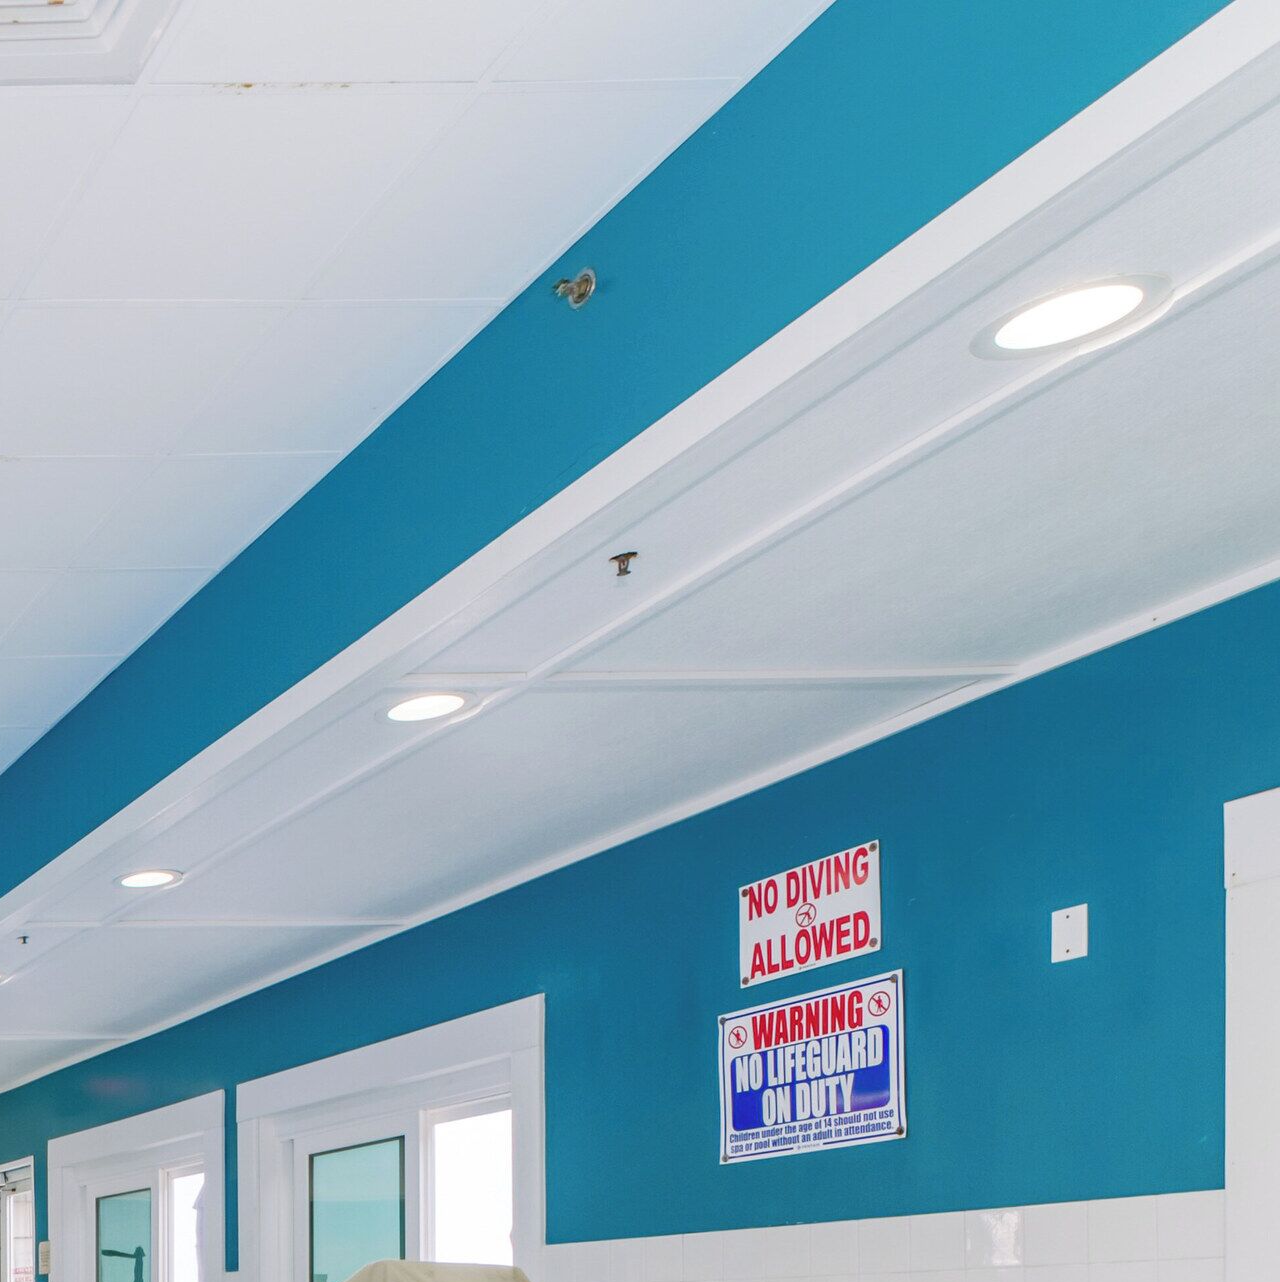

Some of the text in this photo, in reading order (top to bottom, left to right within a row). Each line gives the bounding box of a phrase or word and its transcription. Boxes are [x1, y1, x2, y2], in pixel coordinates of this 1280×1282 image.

[748, 847, 869, 921] NO DIVING
[751, 990, 863, 1050] WARNING
[735, 1027, 883, 1093] NO LIFEGUARD
[729, 1108, 894, 1144] Children under the age of 14 should not use
[761, 1072, 854, 1127] ON DUTY
[730, 1144, 744, 1154] spa
[745, 1143, 753, 1152] or
[754, 1139, 770, 1151] pool
[771, 1135, 800, 1147] without
[801, 1134, 811, 1143] an
[812, 1129, 833, 1141] adult
[834, 1127, 843, 1138] in
[844, 1120, 895, 1136] attendance.
